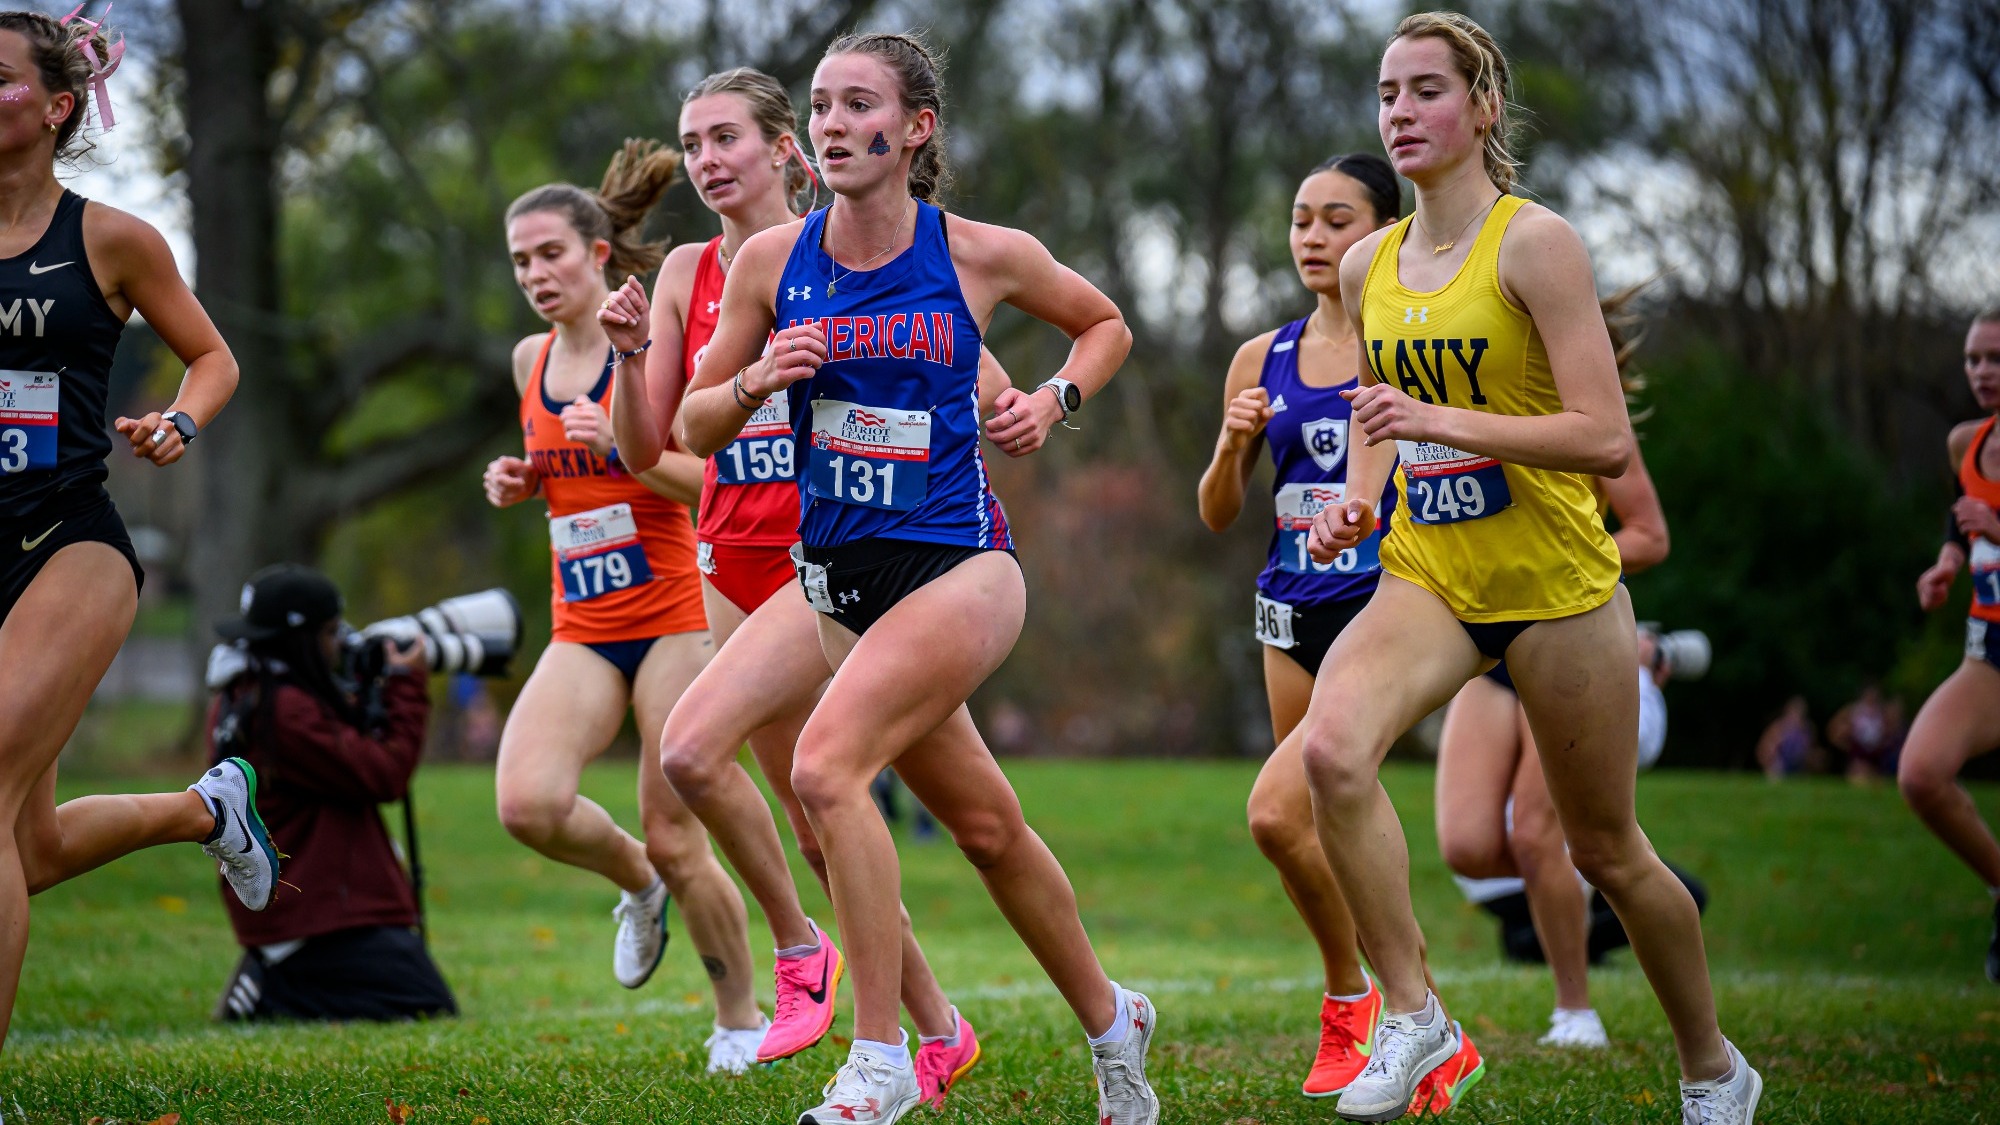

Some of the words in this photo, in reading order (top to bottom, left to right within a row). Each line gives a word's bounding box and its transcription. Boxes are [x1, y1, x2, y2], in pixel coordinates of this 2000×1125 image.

[789, 312, 954, 368] MERICAN
[749, 414, 780, 423] AGUE
[841, 422, 891, 436] PATRIOT
[841, 430, 891, 444] LEAGUE
[726, 438, 795, 481] 159
[1417, 452, 1460, 462] LEAGUE
[828, 455, 895, 506] 131
[1417, 475, 1486, 521] 249
[570, 551, 633, 598] 179
